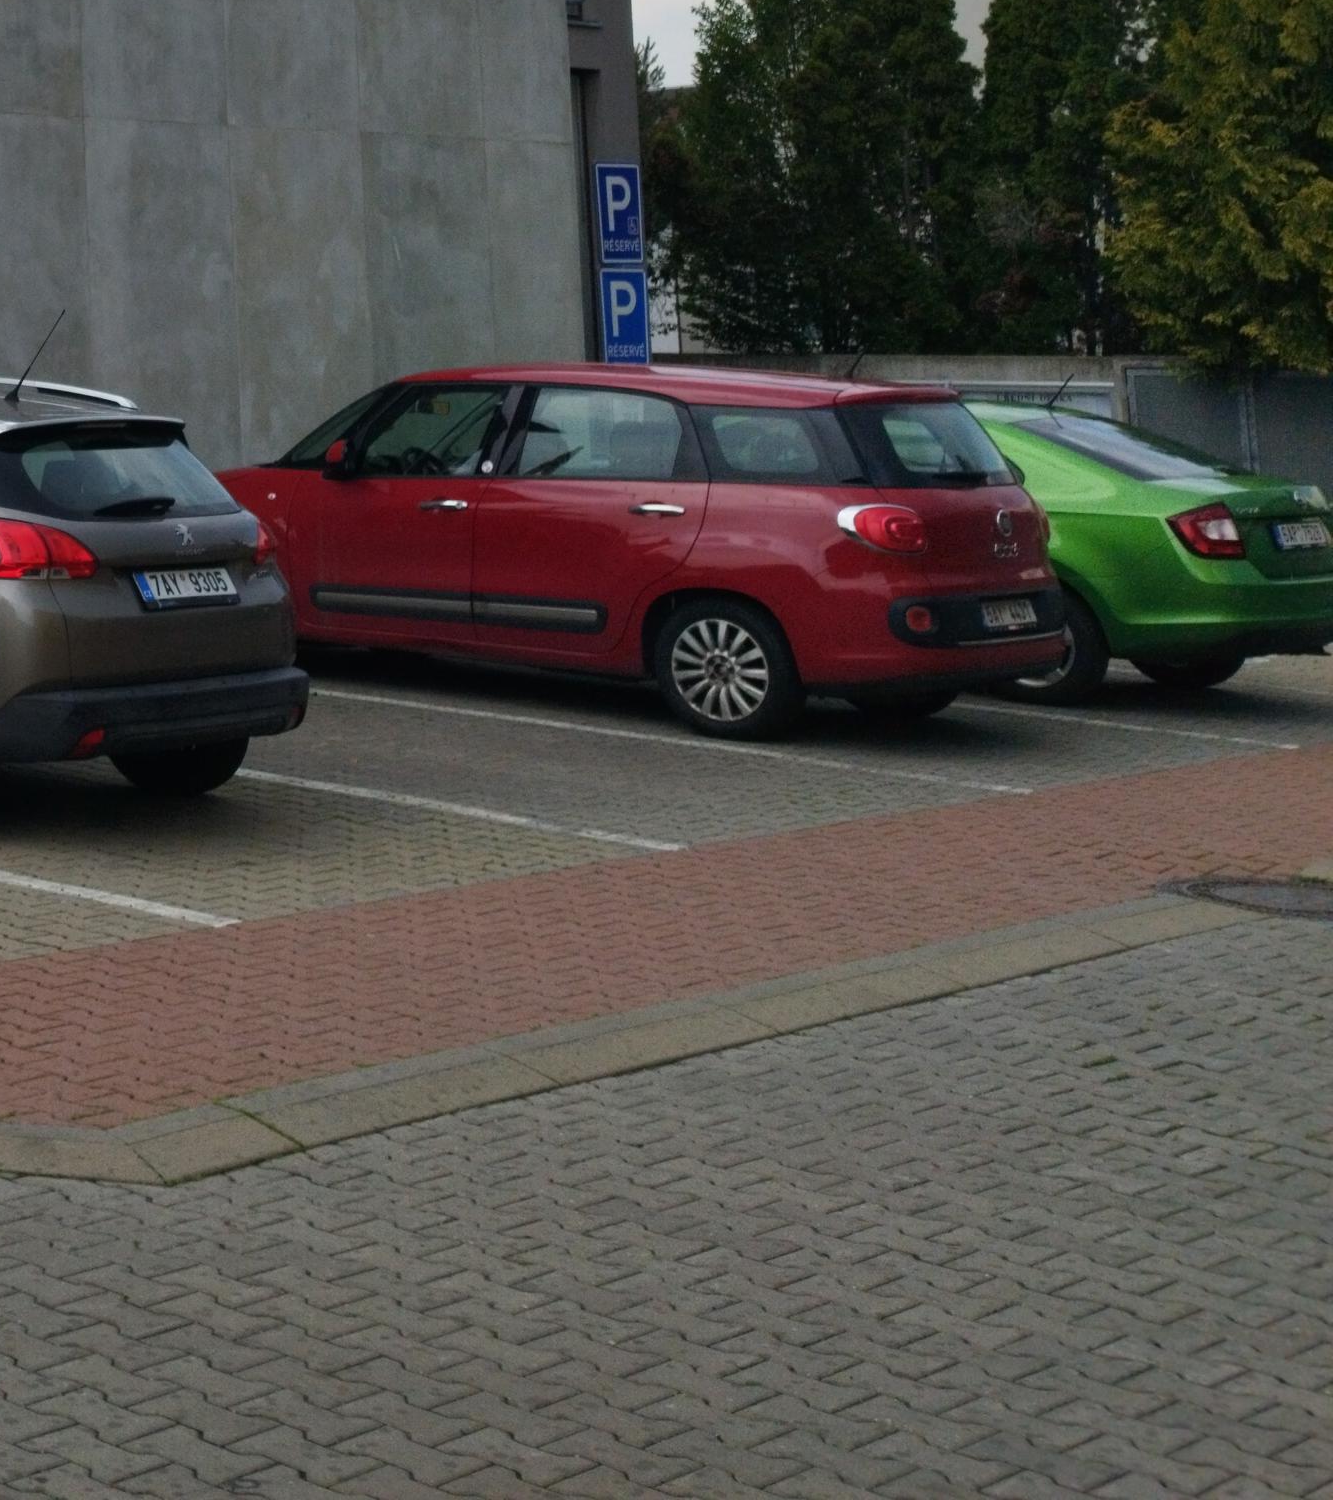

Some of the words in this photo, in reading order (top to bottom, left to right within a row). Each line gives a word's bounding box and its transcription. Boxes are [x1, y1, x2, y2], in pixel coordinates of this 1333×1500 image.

[605, 175, 632, 232] P
[603, 237, 641, 253] RÉSERVÉ
[610, 280, 637, 337] P
[607, 341, 646, 357] RÉSERVÉ
[148, 572, 182, 597] 7AY
[189, 570, 229, 593] 9305
